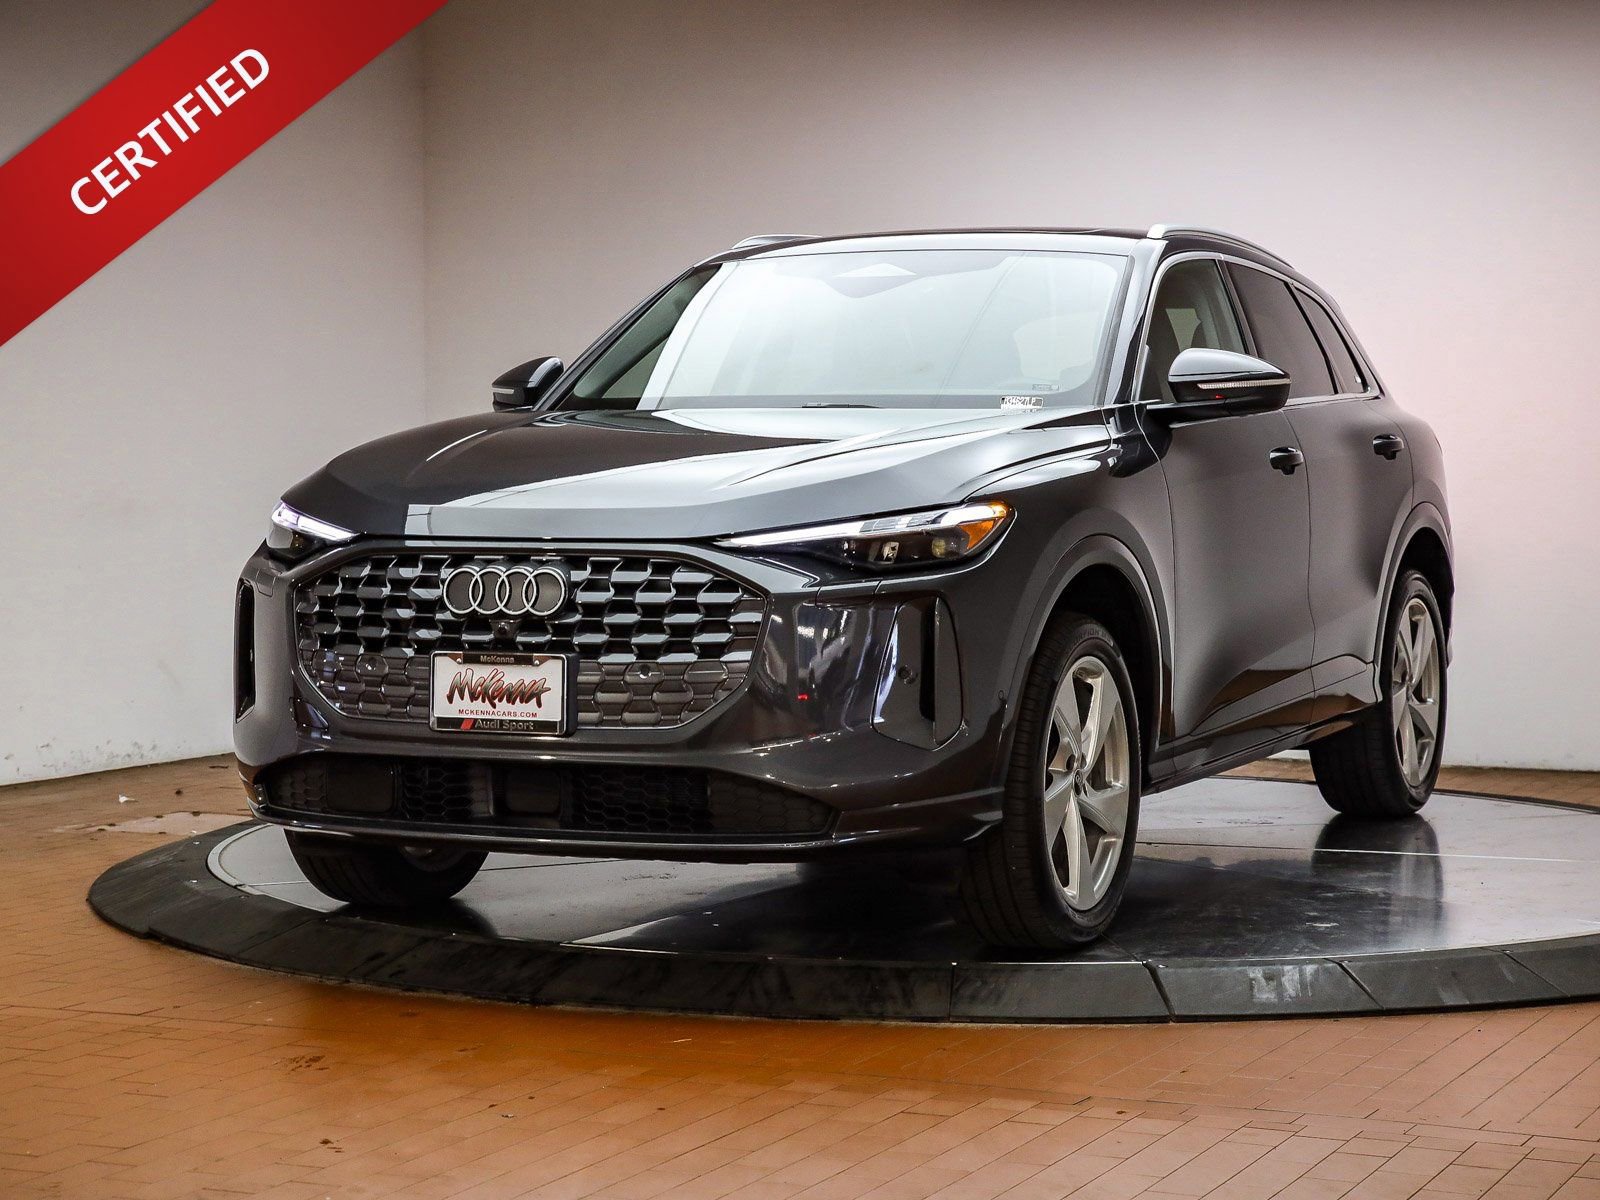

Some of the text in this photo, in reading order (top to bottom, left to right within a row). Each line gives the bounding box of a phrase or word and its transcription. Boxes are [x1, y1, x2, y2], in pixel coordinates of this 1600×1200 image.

[480, 655, 515, 664] McKenna
[446, 667, 552, 709] McKenna
[458, 709, 538, 718] MCKENNACARS.COM
[475, 720, 534, 731] Audi Sport
